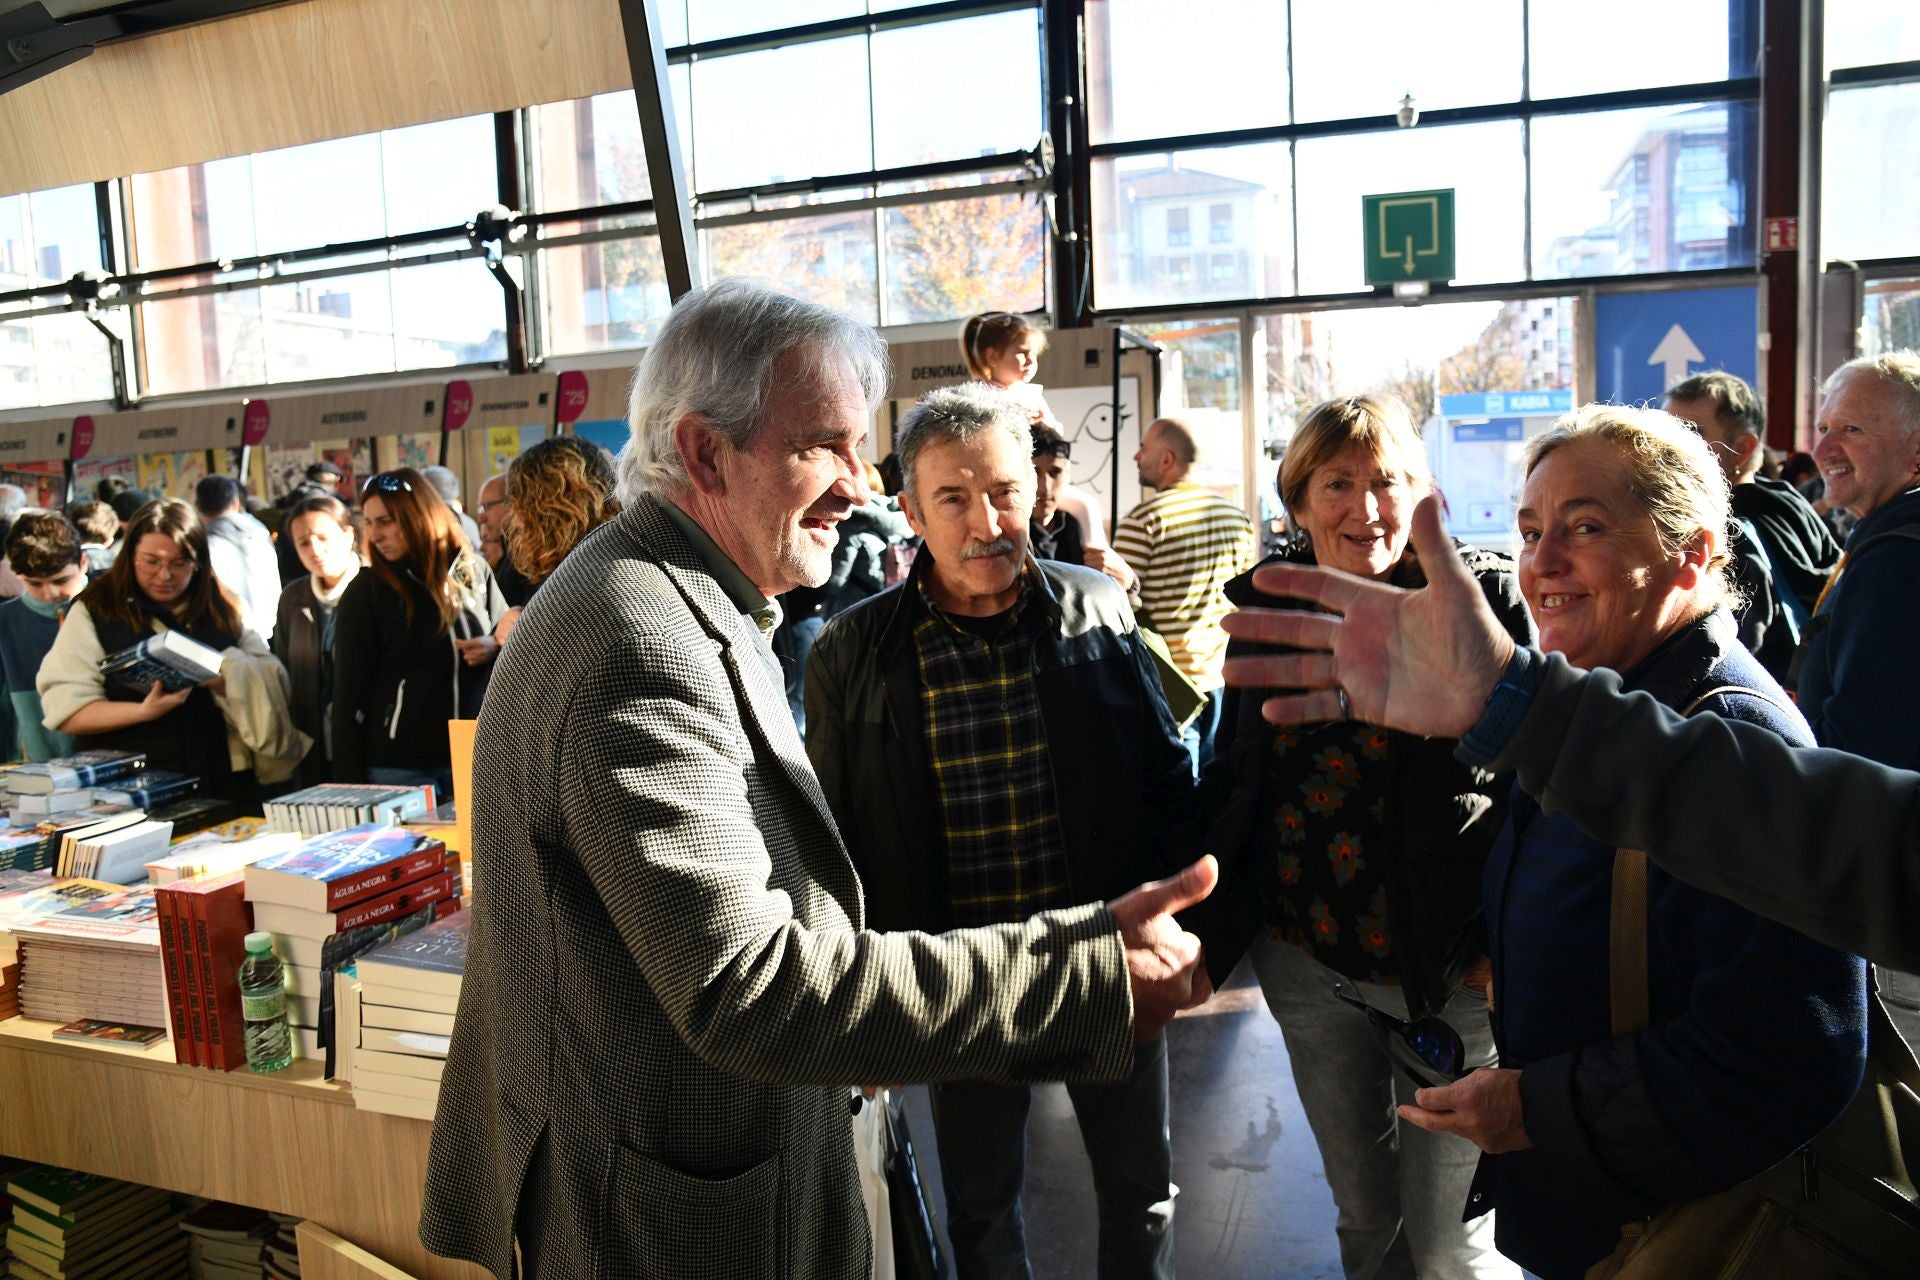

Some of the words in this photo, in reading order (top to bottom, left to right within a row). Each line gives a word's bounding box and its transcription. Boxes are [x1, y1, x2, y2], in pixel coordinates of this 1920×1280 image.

[333, 882, 361, 900] ÁGUILA
[360, 874, 387, 891] NEGRA
[343, 911, 369, 929] ÁGUILA
[368, 903, 395, 920] NEGRA
